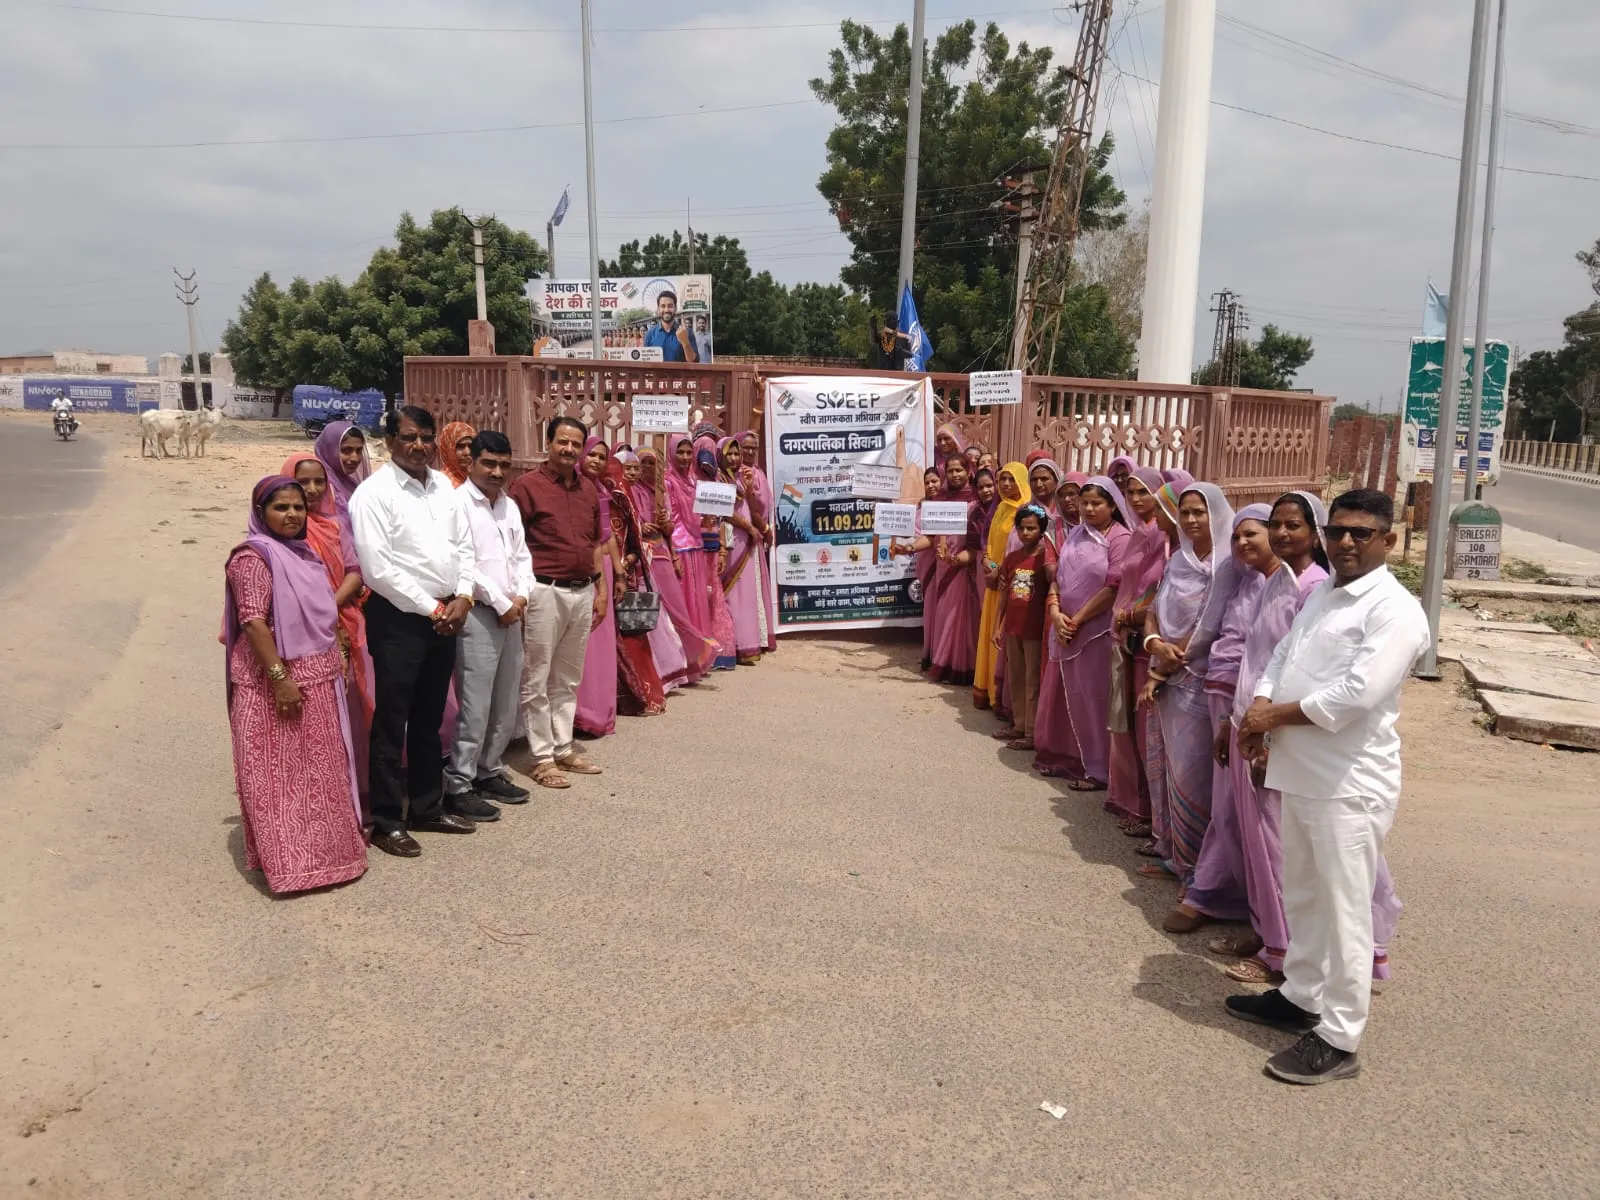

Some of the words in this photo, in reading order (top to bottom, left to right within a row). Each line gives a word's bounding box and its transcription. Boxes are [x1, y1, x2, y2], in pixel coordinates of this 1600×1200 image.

[545, 283, 579, 293] आपका
[600, 280, 617, 293] वोट
[545, 294, 565, 310] देश
[567, 294, 583, 309] की
[586, 297, 618, 309] तकत
[232, 391, 259, 402] सबसे
[302, 397, 361, 410] NUVOCO
[800, 412, 816, 424] स्वीप
[817, 414, 853, 424] जागरूकता
[855, 411, 881, 423] अभियान
[783, 434, 846, 452] नगरपालिका
[848, 433, 882, 450] सिवाना
[829, 502, 854, 513] मतदान
[816, 513, 875, 532] 11.09.20
[1460, 529, 1497, 540] BALESAR
[1469, 543, 1485, 553] 108
[1458, 555, 1497, 566] SAMDARI
[1467, 570, 1481, 579] 29
